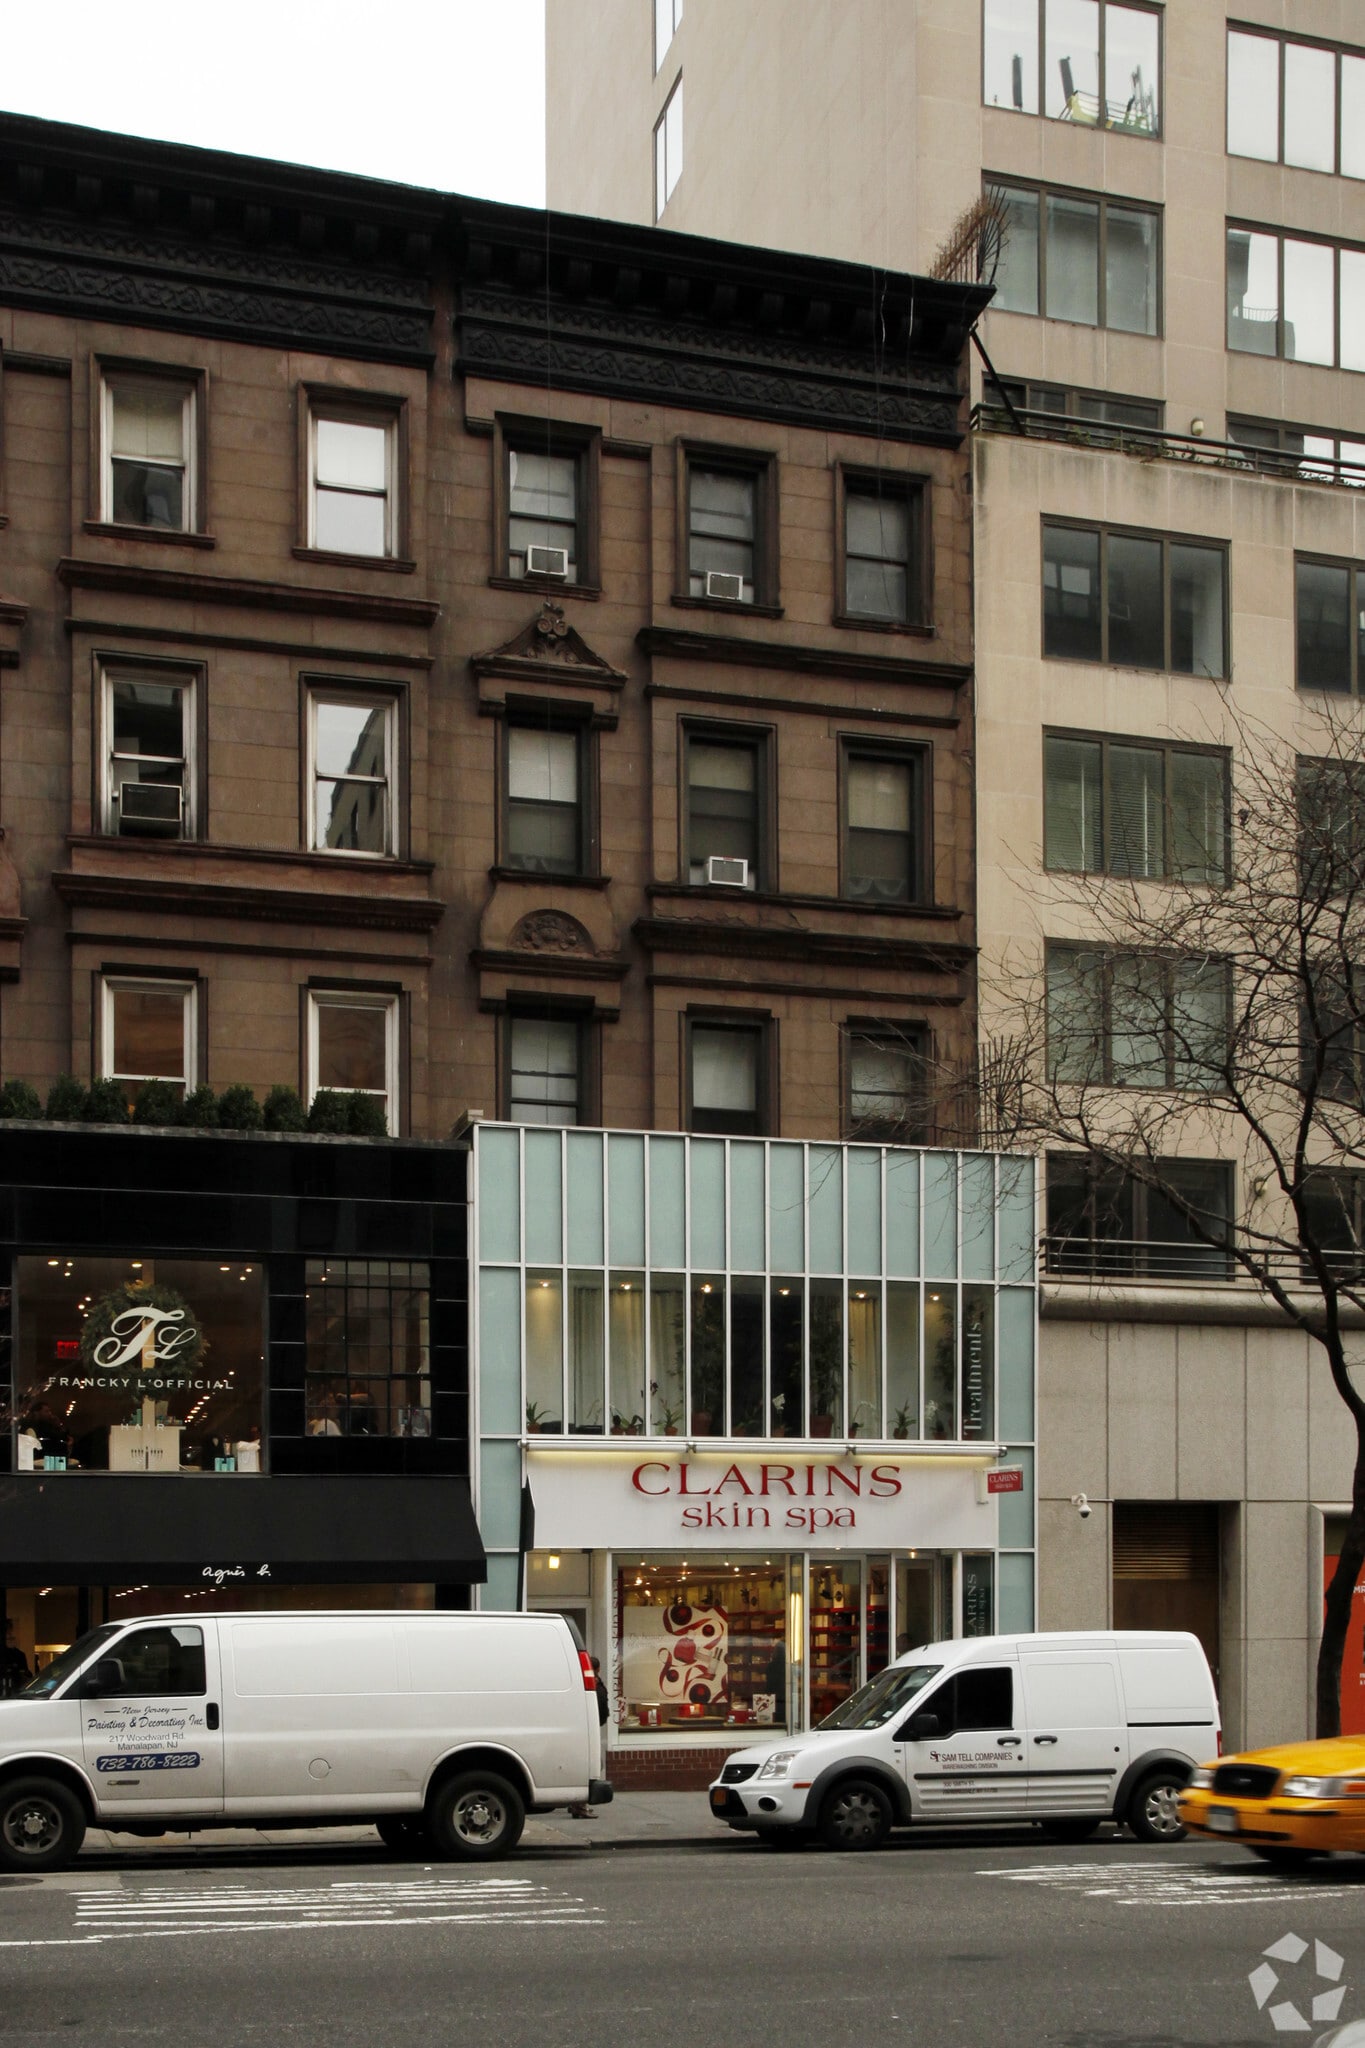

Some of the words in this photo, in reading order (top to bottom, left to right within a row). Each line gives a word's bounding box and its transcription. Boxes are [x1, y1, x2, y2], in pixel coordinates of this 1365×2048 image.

[48, 1376, 130, 1388] FRANCKY
[137, 1378, 234, 1390] L'OFFICIAL
[963, 1322, 982, 1436] Treatments
[120, 1423, 165, 1431] HAIR
[631, 1462, 903, 1498] CLARINS
[681, 1501, 771, 1528] skin
[785, 1507, 856, 1534] spa
[121, 1706, 141, 1714] New
[143, 1706, 171, 1716] Jersey
[87, 1718, 126, 1732] Painting
[129, 1716, 137, 1728] &
[138, 1716, 186, 1729] Decorating
[109, 1734, 126, 1743] 217
[126, 1732, 171, 1742] Woodward
[166, 1741, 179, 1749] NJ
[99, 1754, 197, 1770] 732-786-8222
[941, 1753, 957, 1762] SAM
[957, 1752, 974, 1762] TELL
[974, 1752, 1013, 1761] COMPANIES
